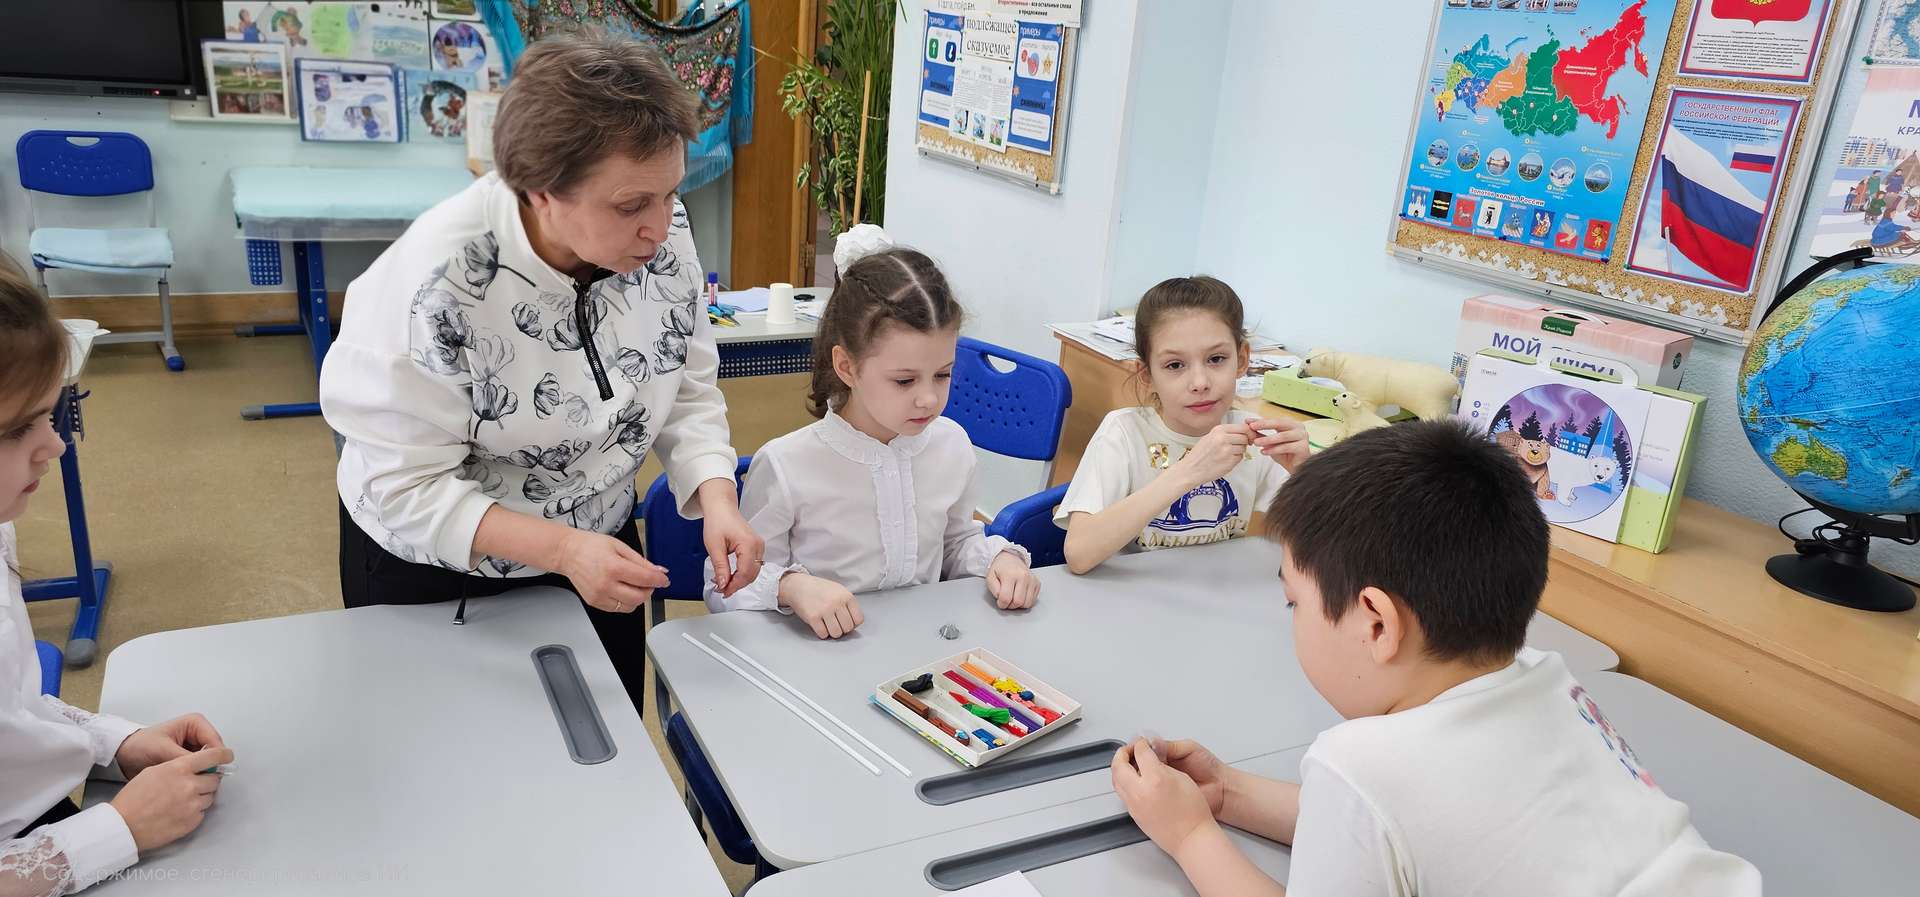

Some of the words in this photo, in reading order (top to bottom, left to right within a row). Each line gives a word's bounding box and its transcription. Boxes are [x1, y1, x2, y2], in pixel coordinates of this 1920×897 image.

[966, 18, 1017, 34] подлежащее
[967, 39, 1011, 57] сказуемое
[1759, 108, 1779, 116] ФЛАГ
[1731, 115, 1780, 126] ФЕДЕРАЦИИ
[1519, 196, 1545, 206] России
[1492, 332, 1541, 357] МОЙ
